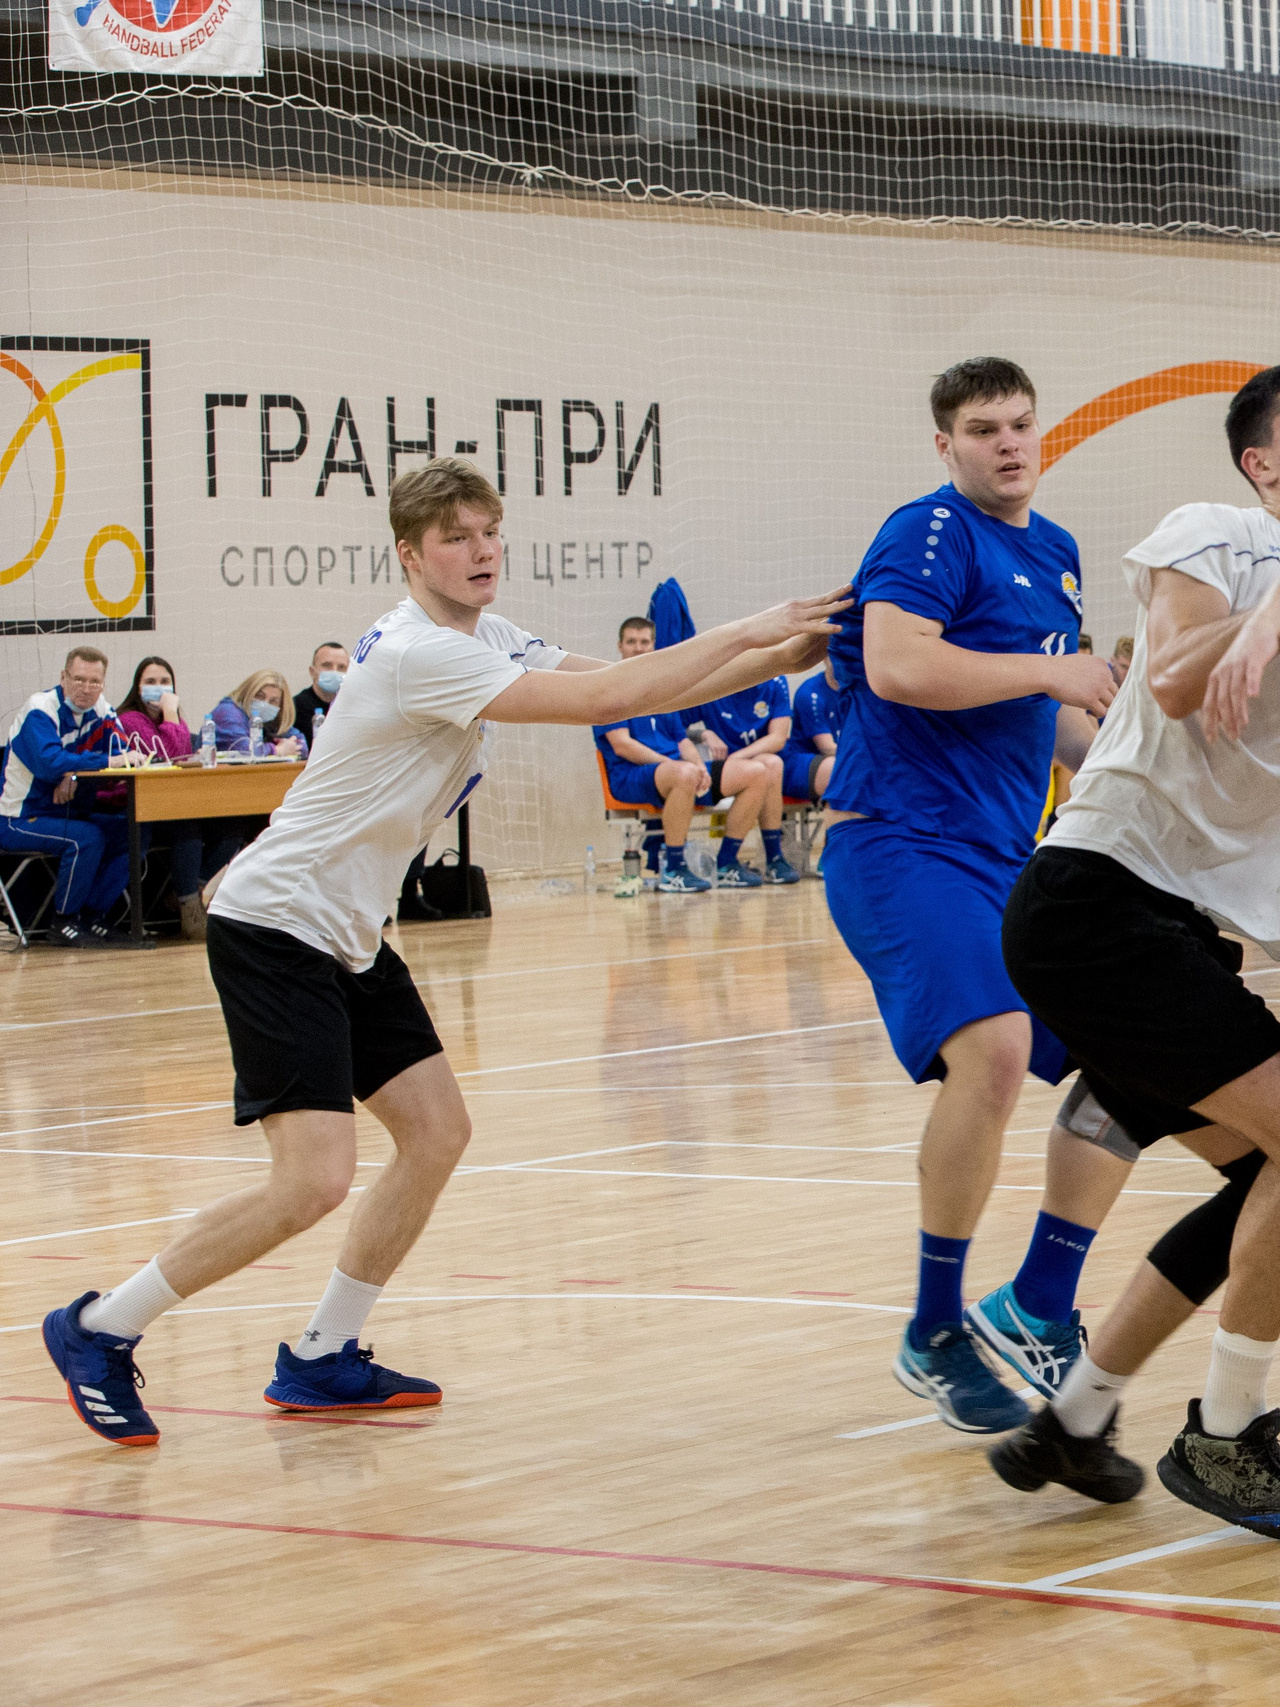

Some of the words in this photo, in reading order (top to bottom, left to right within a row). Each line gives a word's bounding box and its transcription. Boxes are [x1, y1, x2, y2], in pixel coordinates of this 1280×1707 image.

[102, 14, 178, 58] HANDBALL
[204, 393, 663, 497] ГРАН-ПРИ
[220, 538, 510, 588] СПОРТИ
[532, 541, 654, 588] ЦЕНТР
